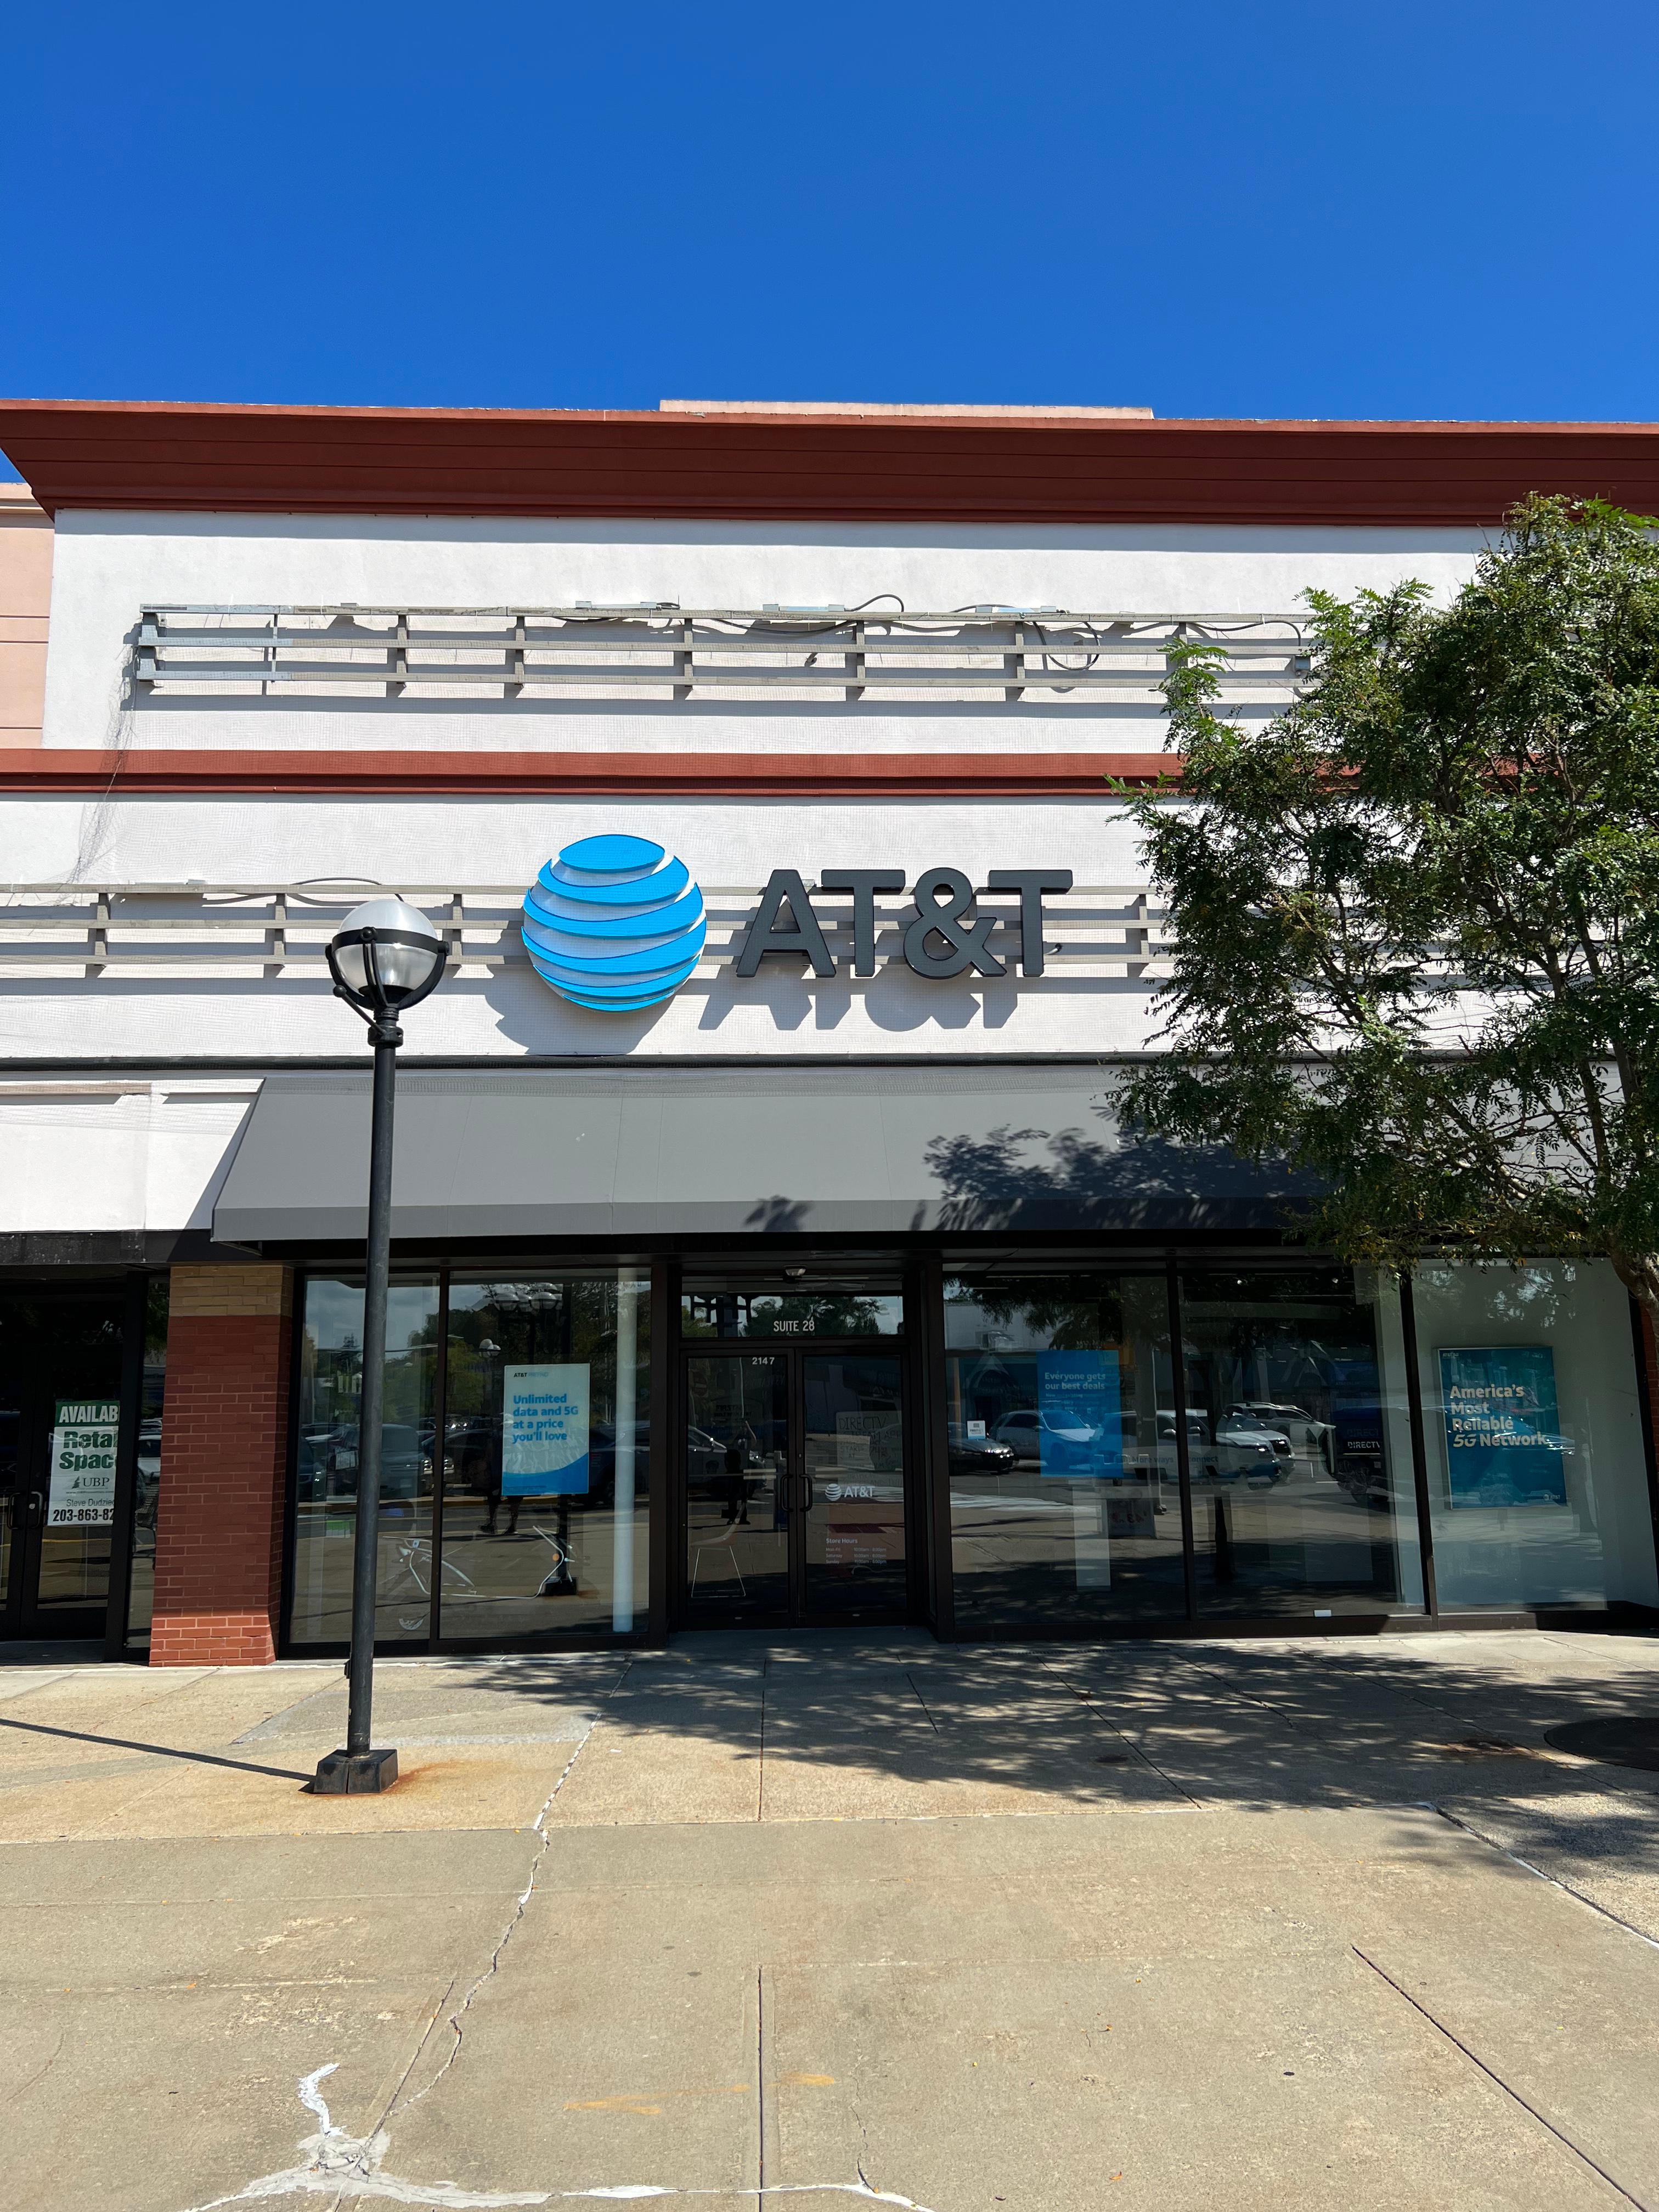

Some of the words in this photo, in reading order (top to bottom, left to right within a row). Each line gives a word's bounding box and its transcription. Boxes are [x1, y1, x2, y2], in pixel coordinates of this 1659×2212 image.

[736, 867, 1073, 979] AT&T
[773, 1320, 799, 1332] SUITE
[802, 1320, 815, 1332] 28
[752, 1357, 775, 1365] 2147
[1045, 1372, 1085, 1381] Everyone
[1087, 1373, 1106, 1382] gets
[1449, 1384, 1525, 1399] America's
[513, 1393, 567, 1404] Unlimited
[513, 1407, 538, 1417] data
[541, 1407, 561, 1415] and
[564, 1406, 579, 1415] 5G
[1451, 1401, 1490, 1415] Most
[59, 1406, 120, 1423] AVAILAB
[513, 1420, 524, 1429] at
[537, 1419, 563, 1430] price
[839, 1417, 887, 1430] DIRECTV
[1452, 1415, 1514, 1431] Reliable
[545, 1431, 567, 1441] love
[1453, 1434, 1477, 1448] 5G
[1480, 1431, 1546, 1447] Network
[59, 1452, 117, 1471] Spac
[83, 1477, 110, 1487] UBP
[844, 1486, 875, 1498] AT&T
[53, 1509, 114, 1521] 203-863-82
